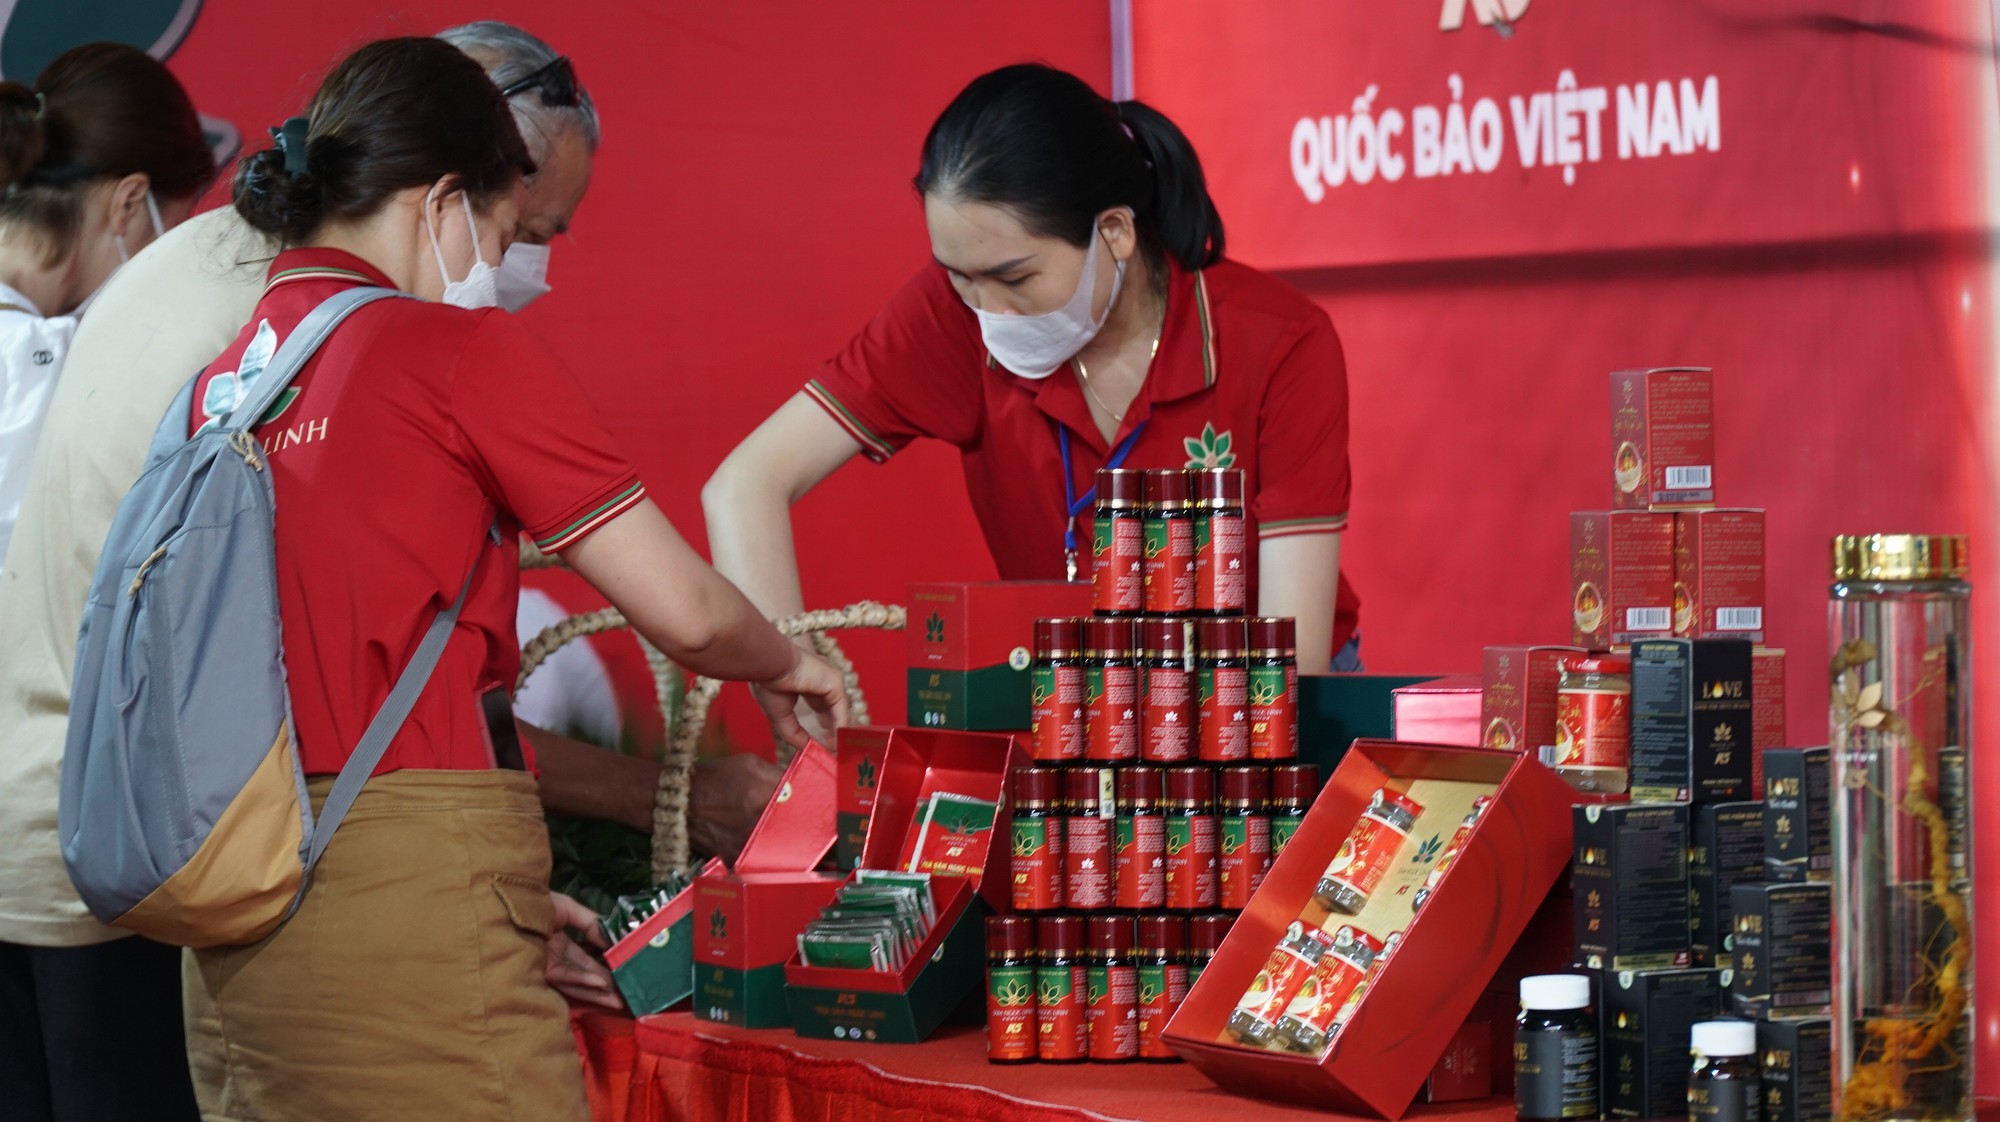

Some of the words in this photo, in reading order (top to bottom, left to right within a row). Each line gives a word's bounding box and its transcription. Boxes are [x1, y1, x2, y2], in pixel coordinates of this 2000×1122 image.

[1290, 84, 1406, 203] QUỐC
[1412, 73, 1503, 178] BẢO
[1509, 69, 1608, 186] VIỆT
[1616, 75, 1721, 159] NAM
[1702, 680, 1744, 699] LOVE
